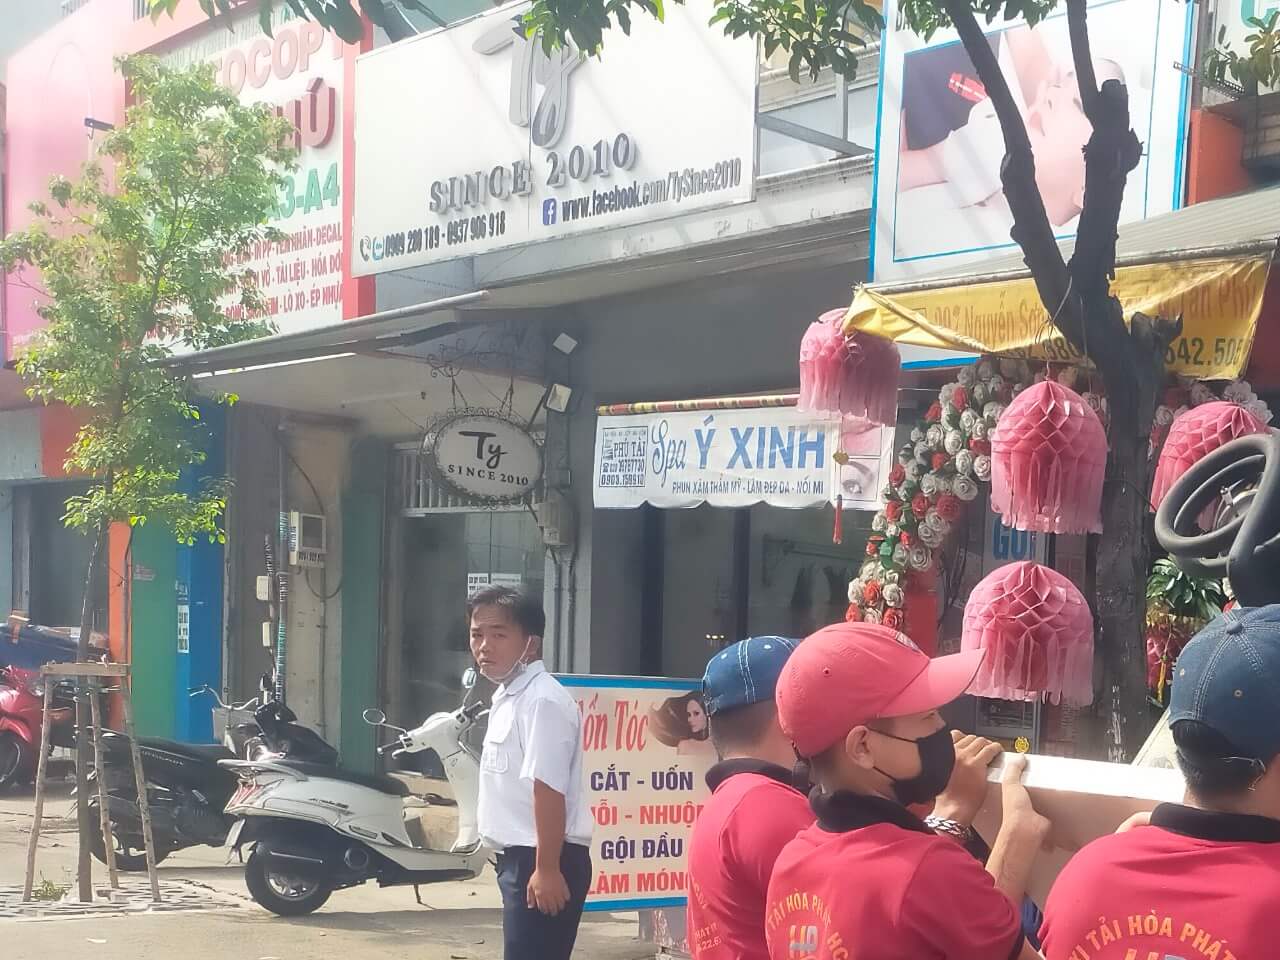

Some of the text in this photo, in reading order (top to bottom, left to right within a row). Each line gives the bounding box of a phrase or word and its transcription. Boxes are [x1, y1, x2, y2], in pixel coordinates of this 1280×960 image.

[429, 132, 640, 214] SINCE 2010
[562, 157, 742, 222] www.facebook.com/TySince2010
[488, 210, 506, 237] 918
[458, 430, 508, 469] Ty
[651, 414, 825, 488] Spa Ý XINH
[447, 464, 529, 486] SINCE 2010
[672, 480, 691, 494] PHUN
[813, 480, 824, 493] MI
[614, 696, 649, 752] Tóc
[590, 764, 631, 791] CẮT
[651, 764, 694, 791] UỐN
[601, 832, 684, 863] GỘI ĐẦU
[1085, 915, 1123, 951] TẢI
[1127, 909, 1173, 938] HÒA
